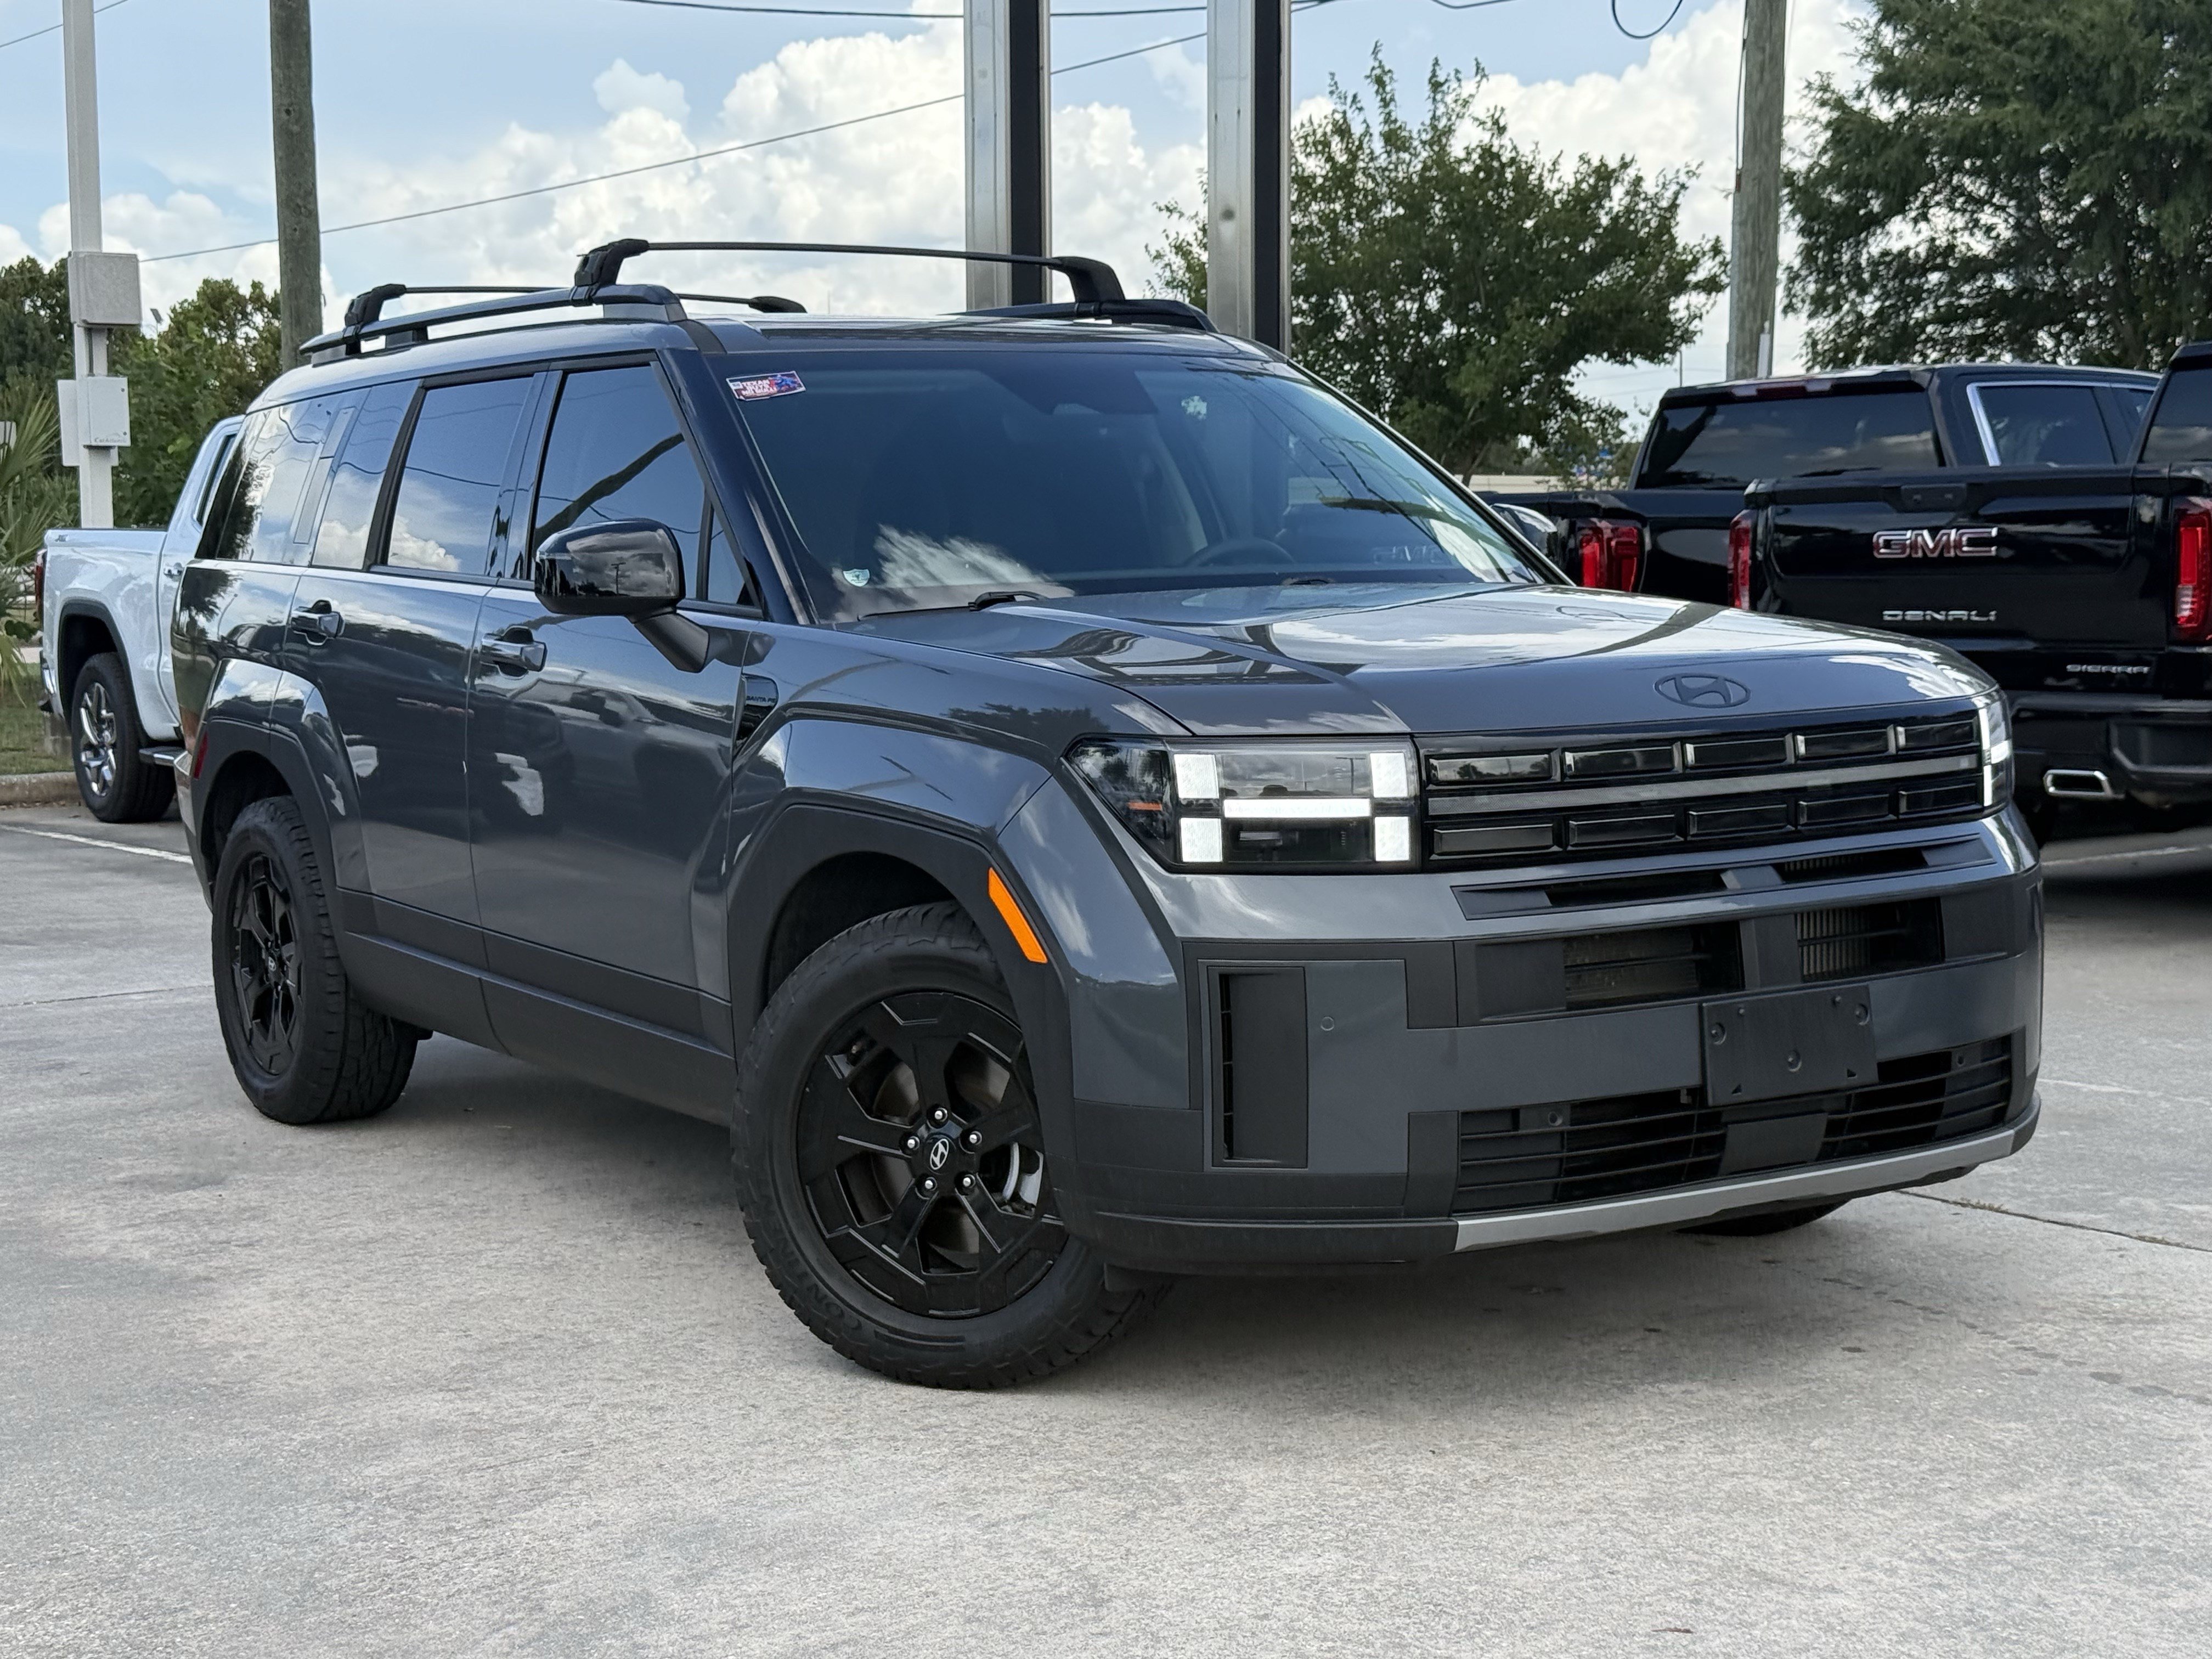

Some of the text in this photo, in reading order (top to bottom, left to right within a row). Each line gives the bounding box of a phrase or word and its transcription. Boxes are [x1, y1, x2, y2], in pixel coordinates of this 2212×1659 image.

[1872, 527, 1999, 558] GMC
[1882, 610, 1997, 621] DENALI
[2066, 664, 2151, 674] SIERRA
